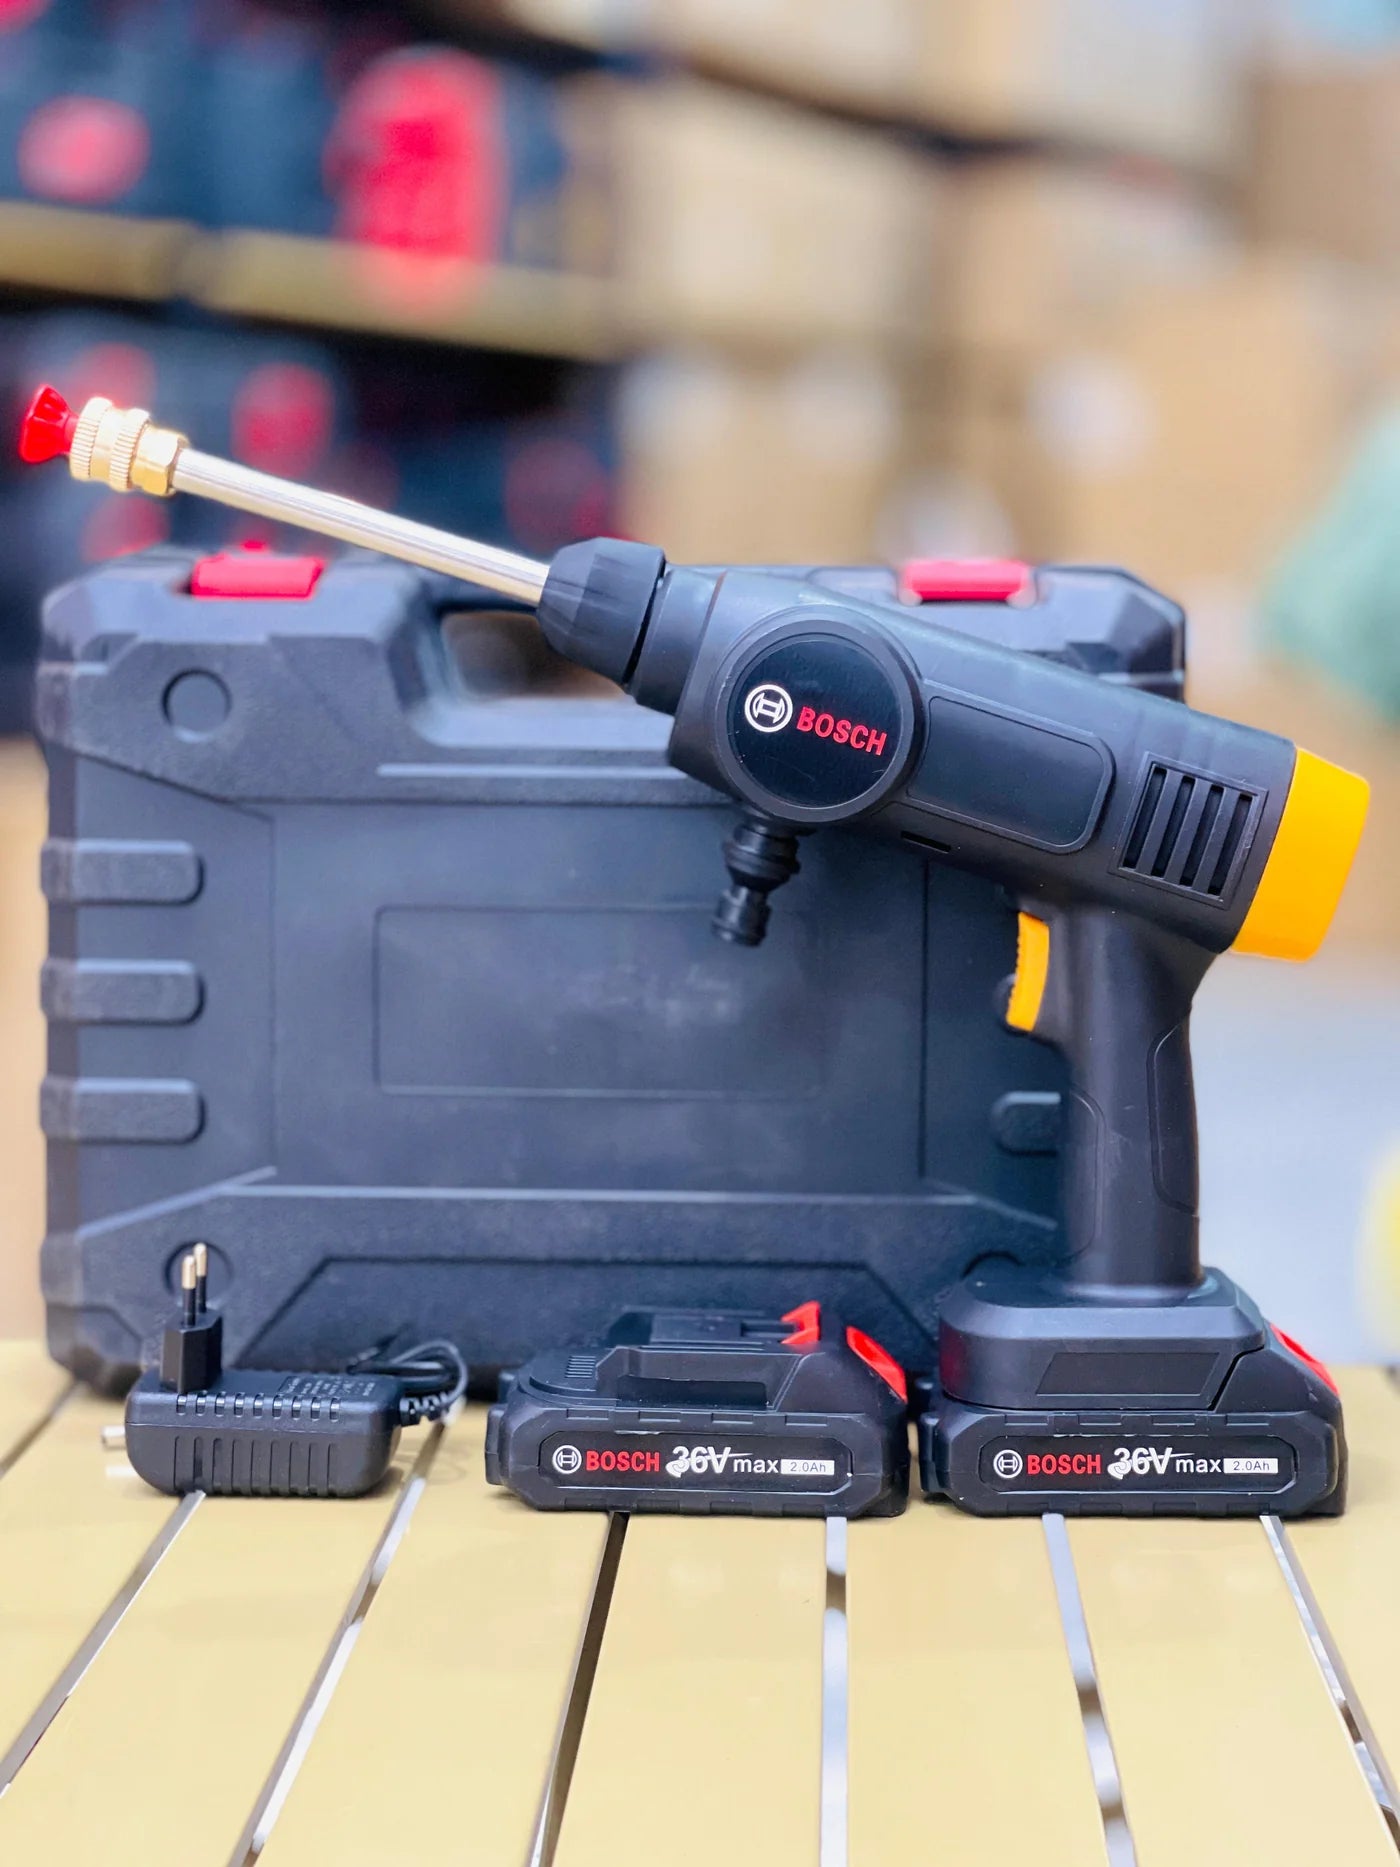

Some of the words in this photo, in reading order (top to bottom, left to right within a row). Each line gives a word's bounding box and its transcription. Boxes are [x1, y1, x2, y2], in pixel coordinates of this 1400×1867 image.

[796, 705, 888, 756] BOSCH
[585, 1450, 660, 1472] BOSCH
[669, 1445, 733, 1476] 36V
[733, 1457, 779, 1474] max
[788, 1461, 827, 1473] 2.0Ah
[1026, 1453, 1101, 1475] BOSCH
[1110, 1446, 1174, 1477] 36V
[1175, 1457, 1222, 1474] max
[1232, 1460, 1271, 1472] 2.0Ah
